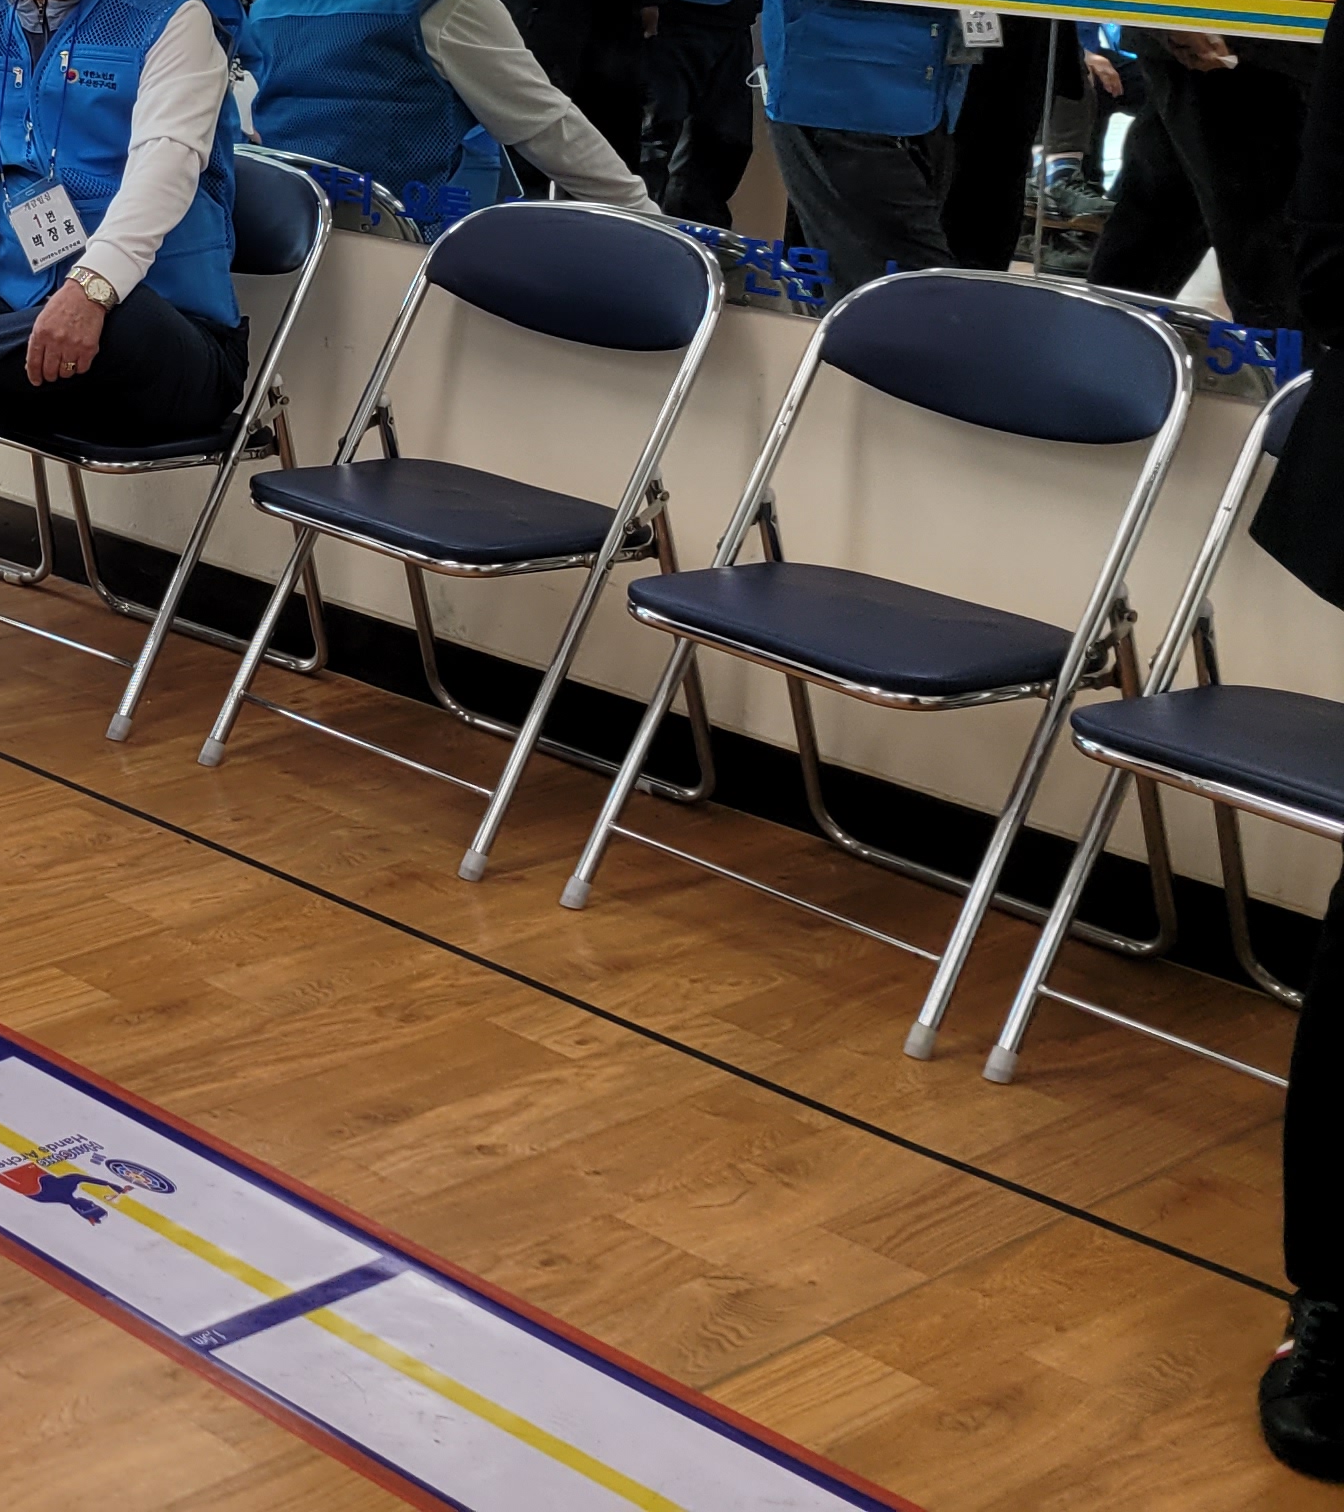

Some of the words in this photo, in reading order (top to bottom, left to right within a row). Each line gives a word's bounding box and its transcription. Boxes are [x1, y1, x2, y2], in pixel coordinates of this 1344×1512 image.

[32, 213, 43, 229] 1
[736, 237, 832, 306] 전문
[38, 1133, 89, 1154] Hands
